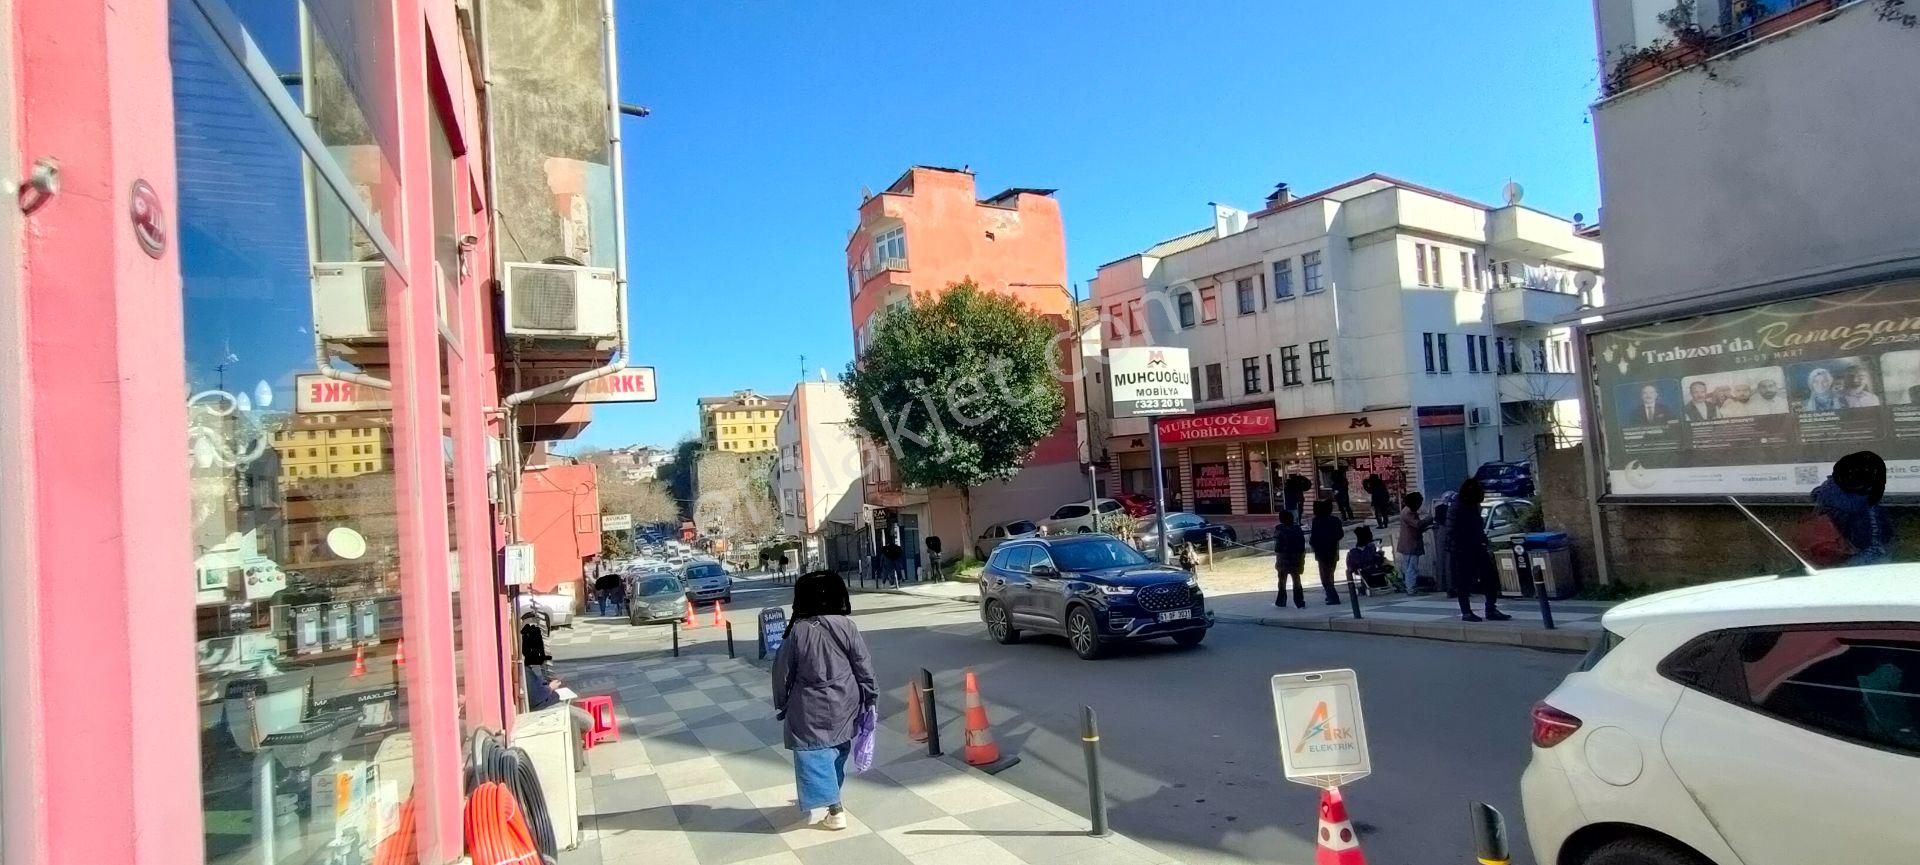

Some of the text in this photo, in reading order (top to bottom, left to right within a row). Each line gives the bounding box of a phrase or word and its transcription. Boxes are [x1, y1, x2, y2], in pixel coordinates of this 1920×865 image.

[1642, 317, 1920, 364] Trabzon'da Ramazan
[1114, 369, 1190, 387] MUHCUOĞLU
[1136, 386, 1179, 397] MOBİLYA
[1140, 398, 1184, 409] 323 20 91
[1159, 413, 1270, 435] MUHCUOĞLU
[1180, 426, 1241, 440] MOBİLYA
[358, 690, 397, 702] MAXLED
